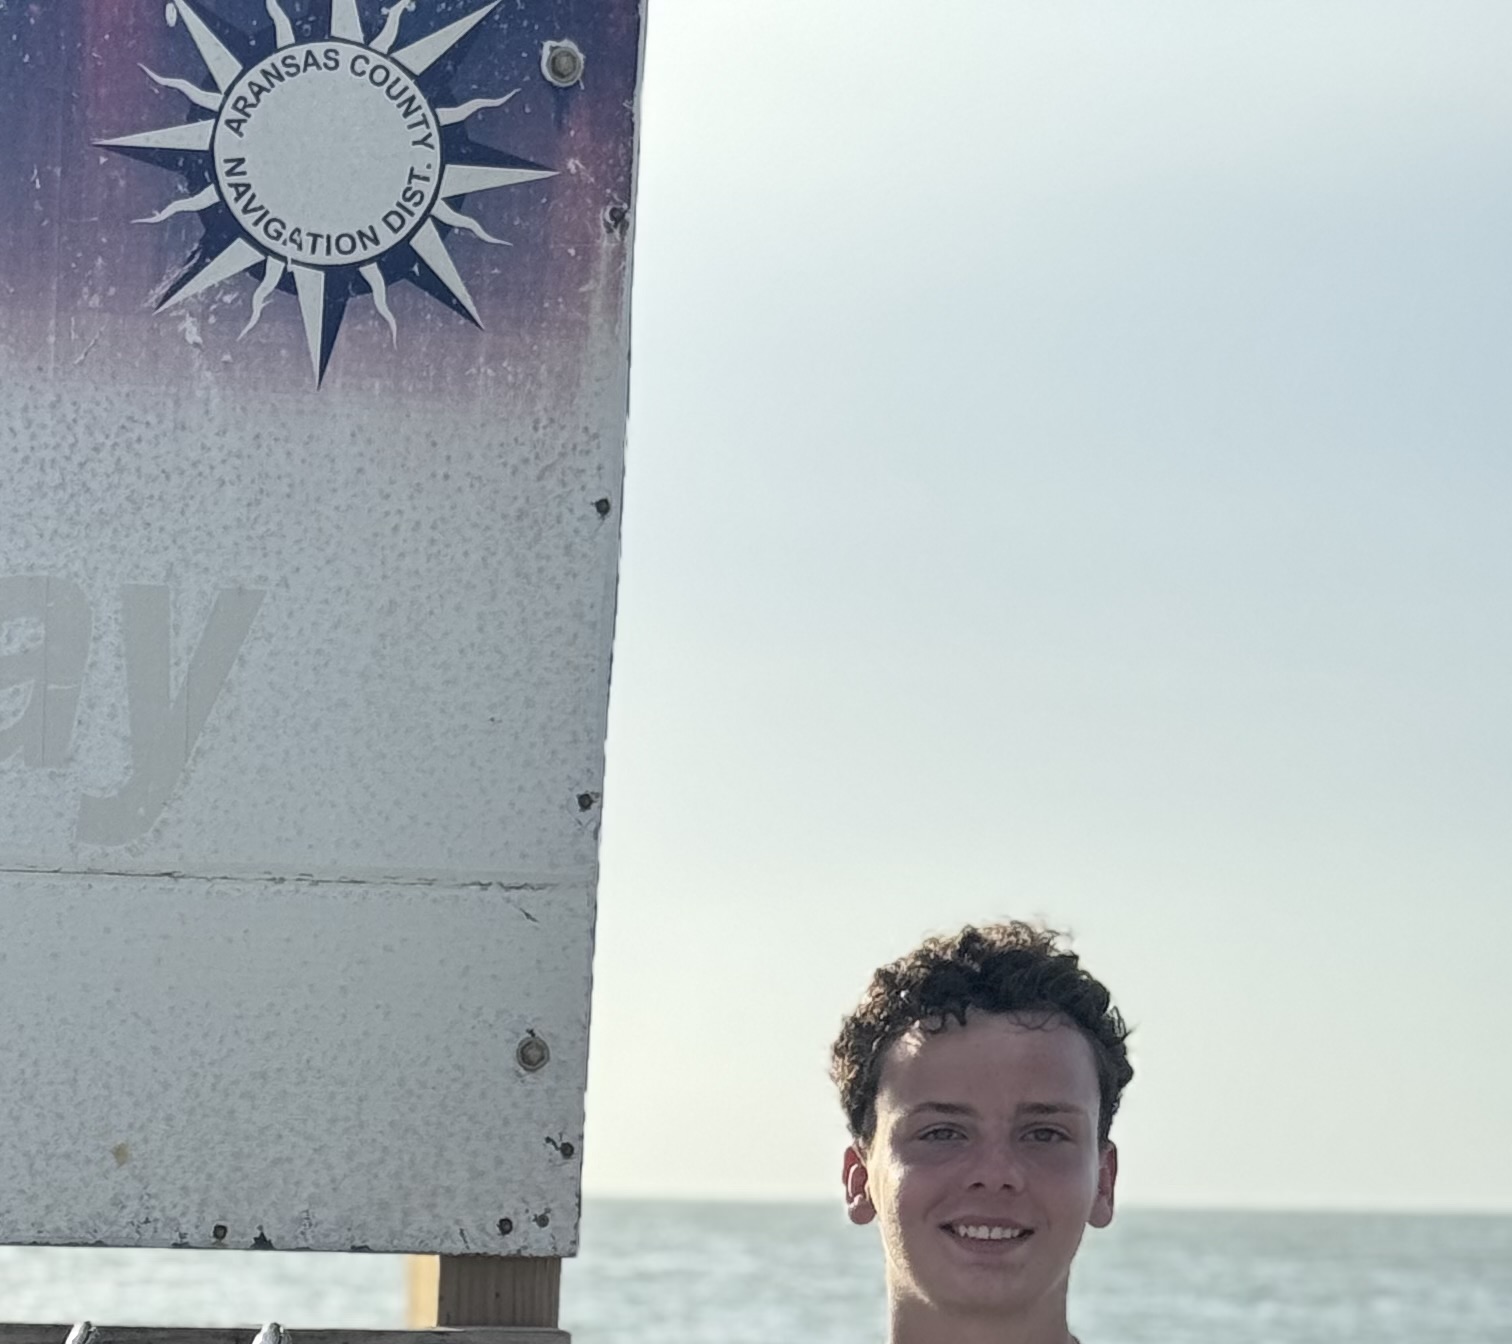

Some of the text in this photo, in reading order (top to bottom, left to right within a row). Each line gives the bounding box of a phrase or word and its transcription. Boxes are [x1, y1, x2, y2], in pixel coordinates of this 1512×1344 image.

[224, 48, 436, 151] ARANSAS COUNTY
[223, 156, 433, 257] NAVIGATION DIST.
